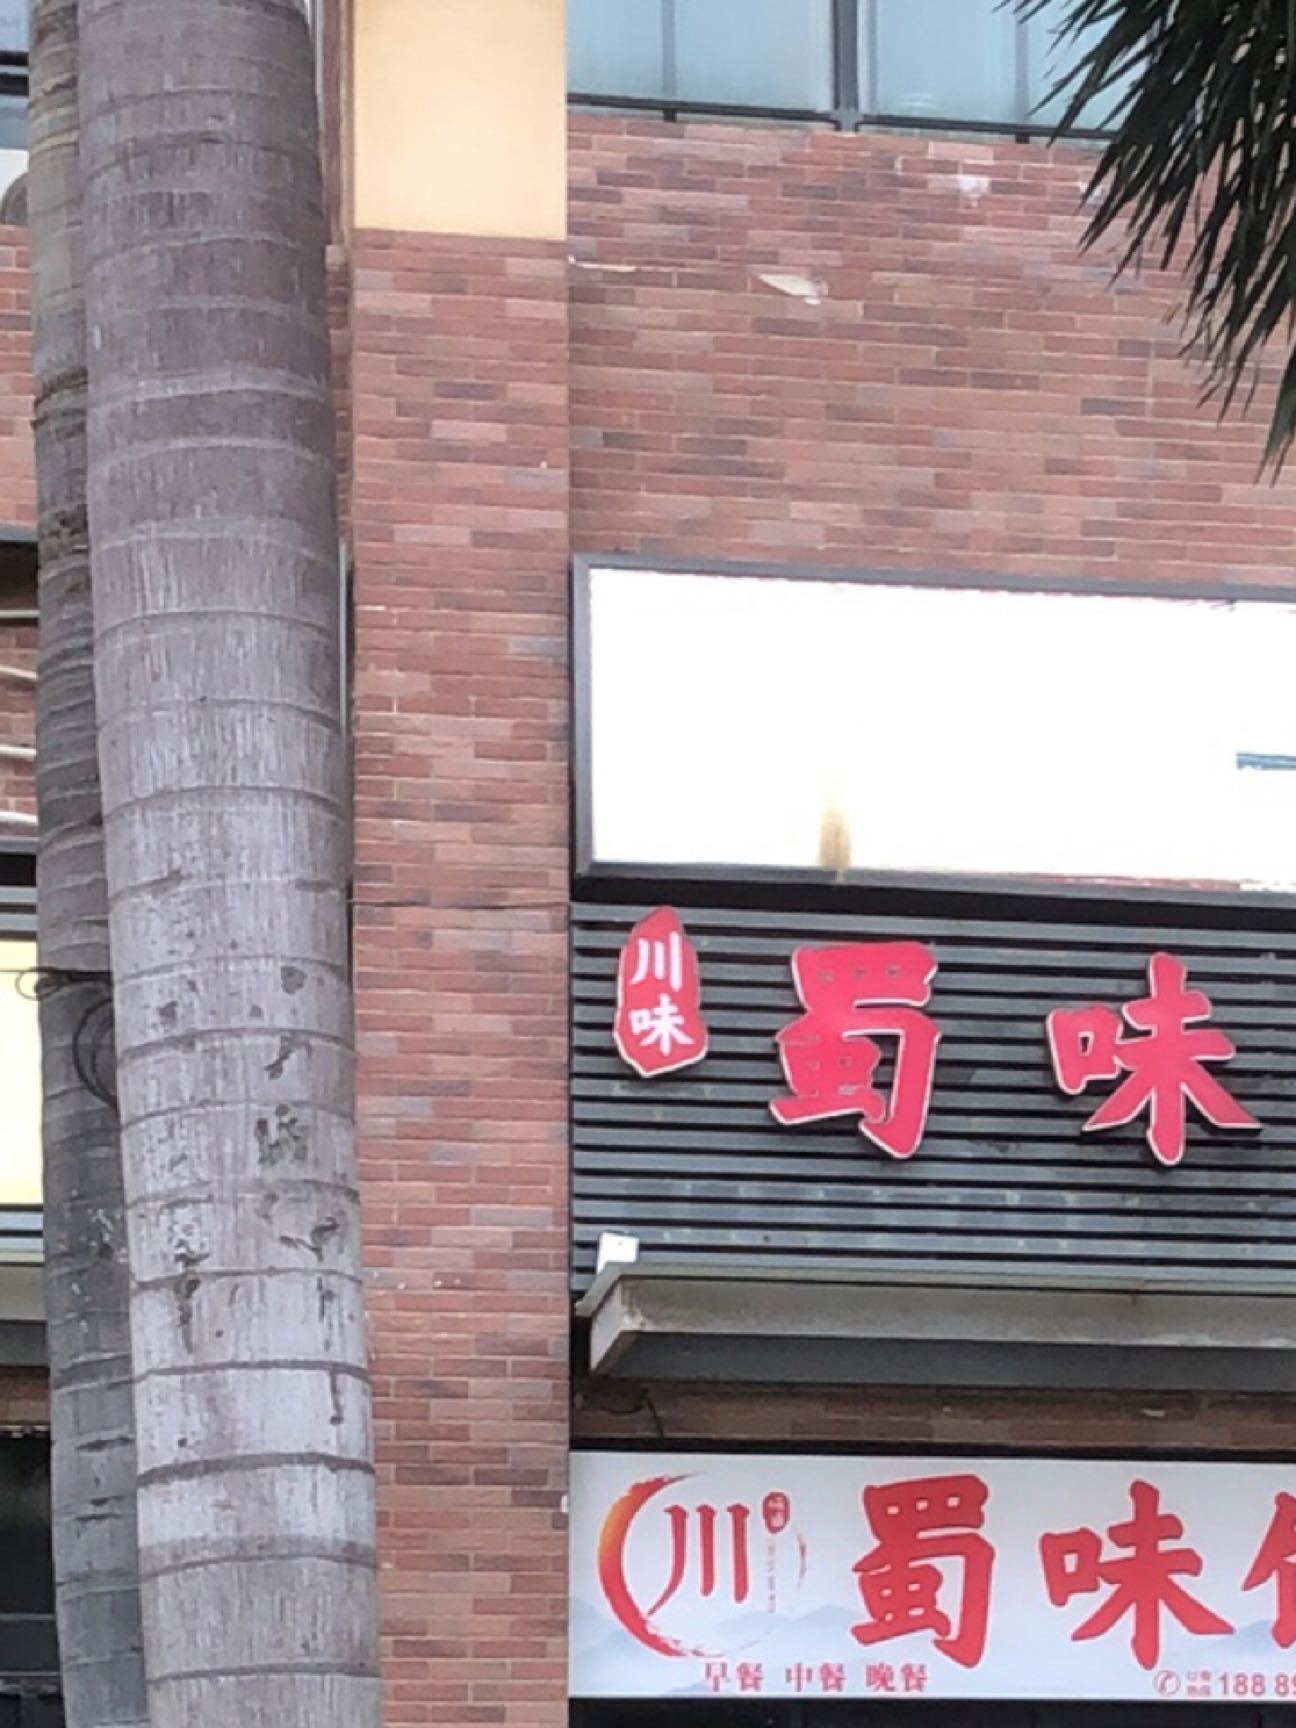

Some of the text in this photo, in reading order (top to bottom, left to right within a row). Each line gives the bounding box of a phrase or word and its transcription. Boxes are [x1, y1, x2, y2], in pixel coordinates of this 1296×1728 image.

[629, 930, 695, 1057] 川味
[704, 1662, 928, 1692] 早餐 中餐 晚餐
[1217, 1673, 1266, 1698] 188
